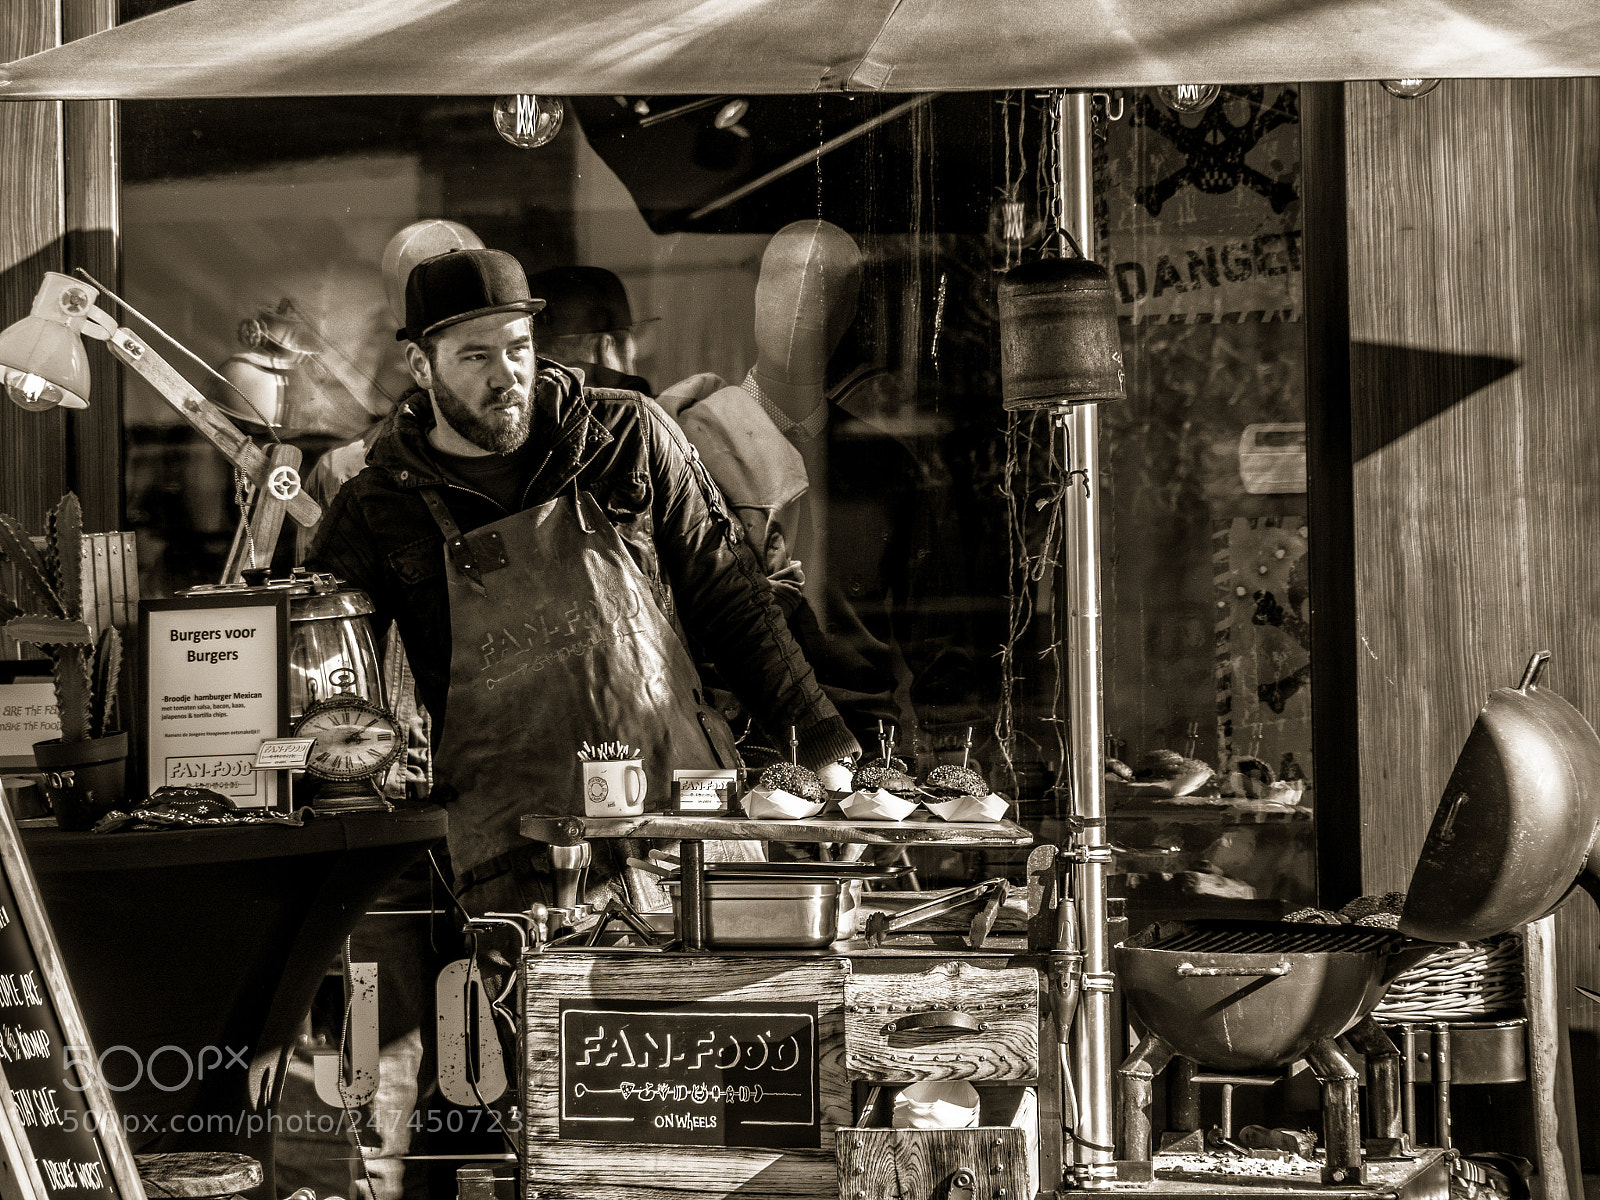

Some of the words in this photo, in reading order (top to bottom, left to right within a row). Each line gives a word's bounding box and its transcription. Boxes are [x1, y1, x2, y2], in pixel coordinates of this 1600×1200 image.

[170, 629, 222, 644] Burgers
[224, 627, 257, 639] voor
[187, 650, 239, 664] Burgers
[194, 693, 232, 702] hamburger
[170, 760, 253, 779] FAN-FOOD
[20, 970, 43, 1008] ARE
[575, 1025, 800, 1072] FAN-FOOD
[32, 1087, 64, 1127] SAFE
[654, 1115, 675, 1128] ON
